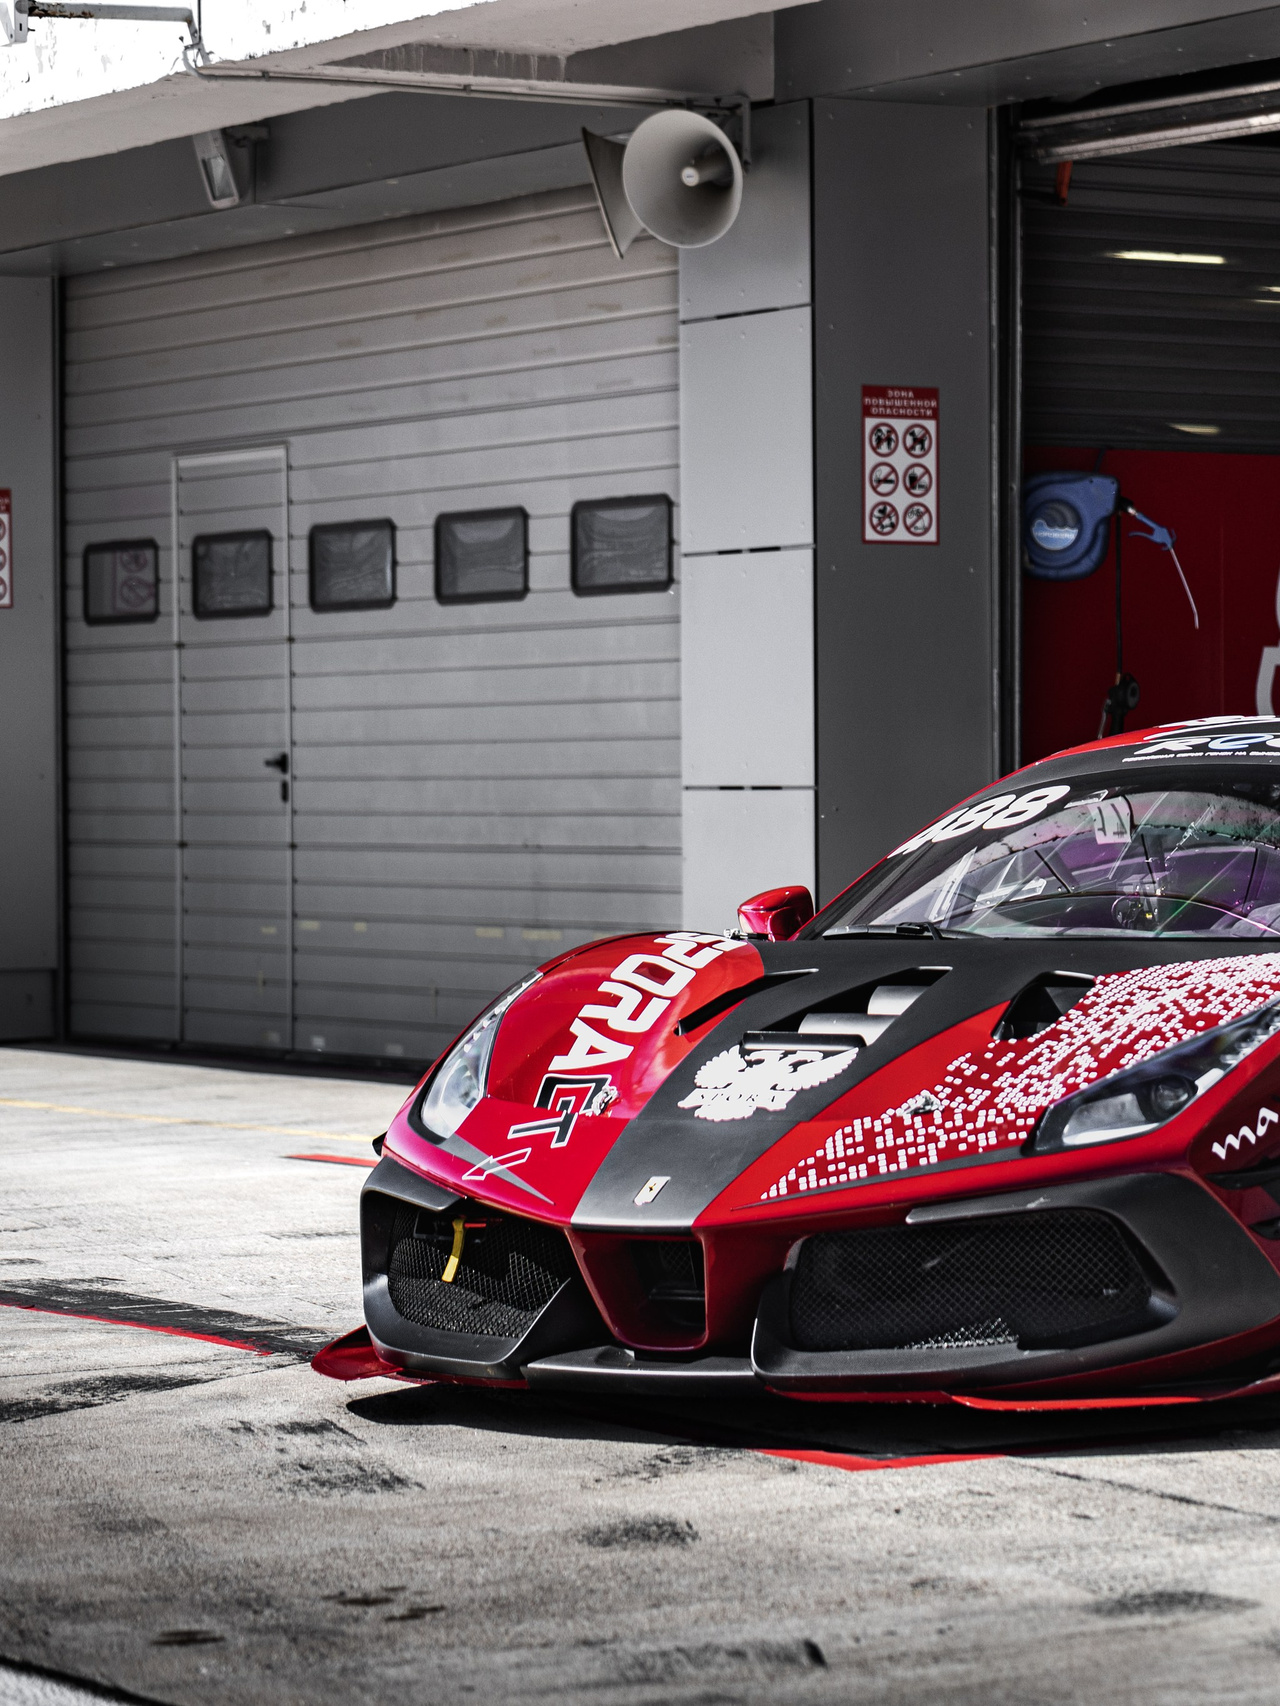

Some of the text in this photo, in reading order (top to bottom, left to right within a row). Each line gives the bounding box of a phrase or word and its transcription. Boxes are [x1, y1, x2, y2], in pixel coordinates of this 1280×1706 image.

[887, 389, 915, 398] ЗОНА
[864, 398, 938, 408] ПОВЫШЕННОЙ
[871, 407, 933, 417] ОПАСНОСТИ
[887, 785, 1071, 859] 488
